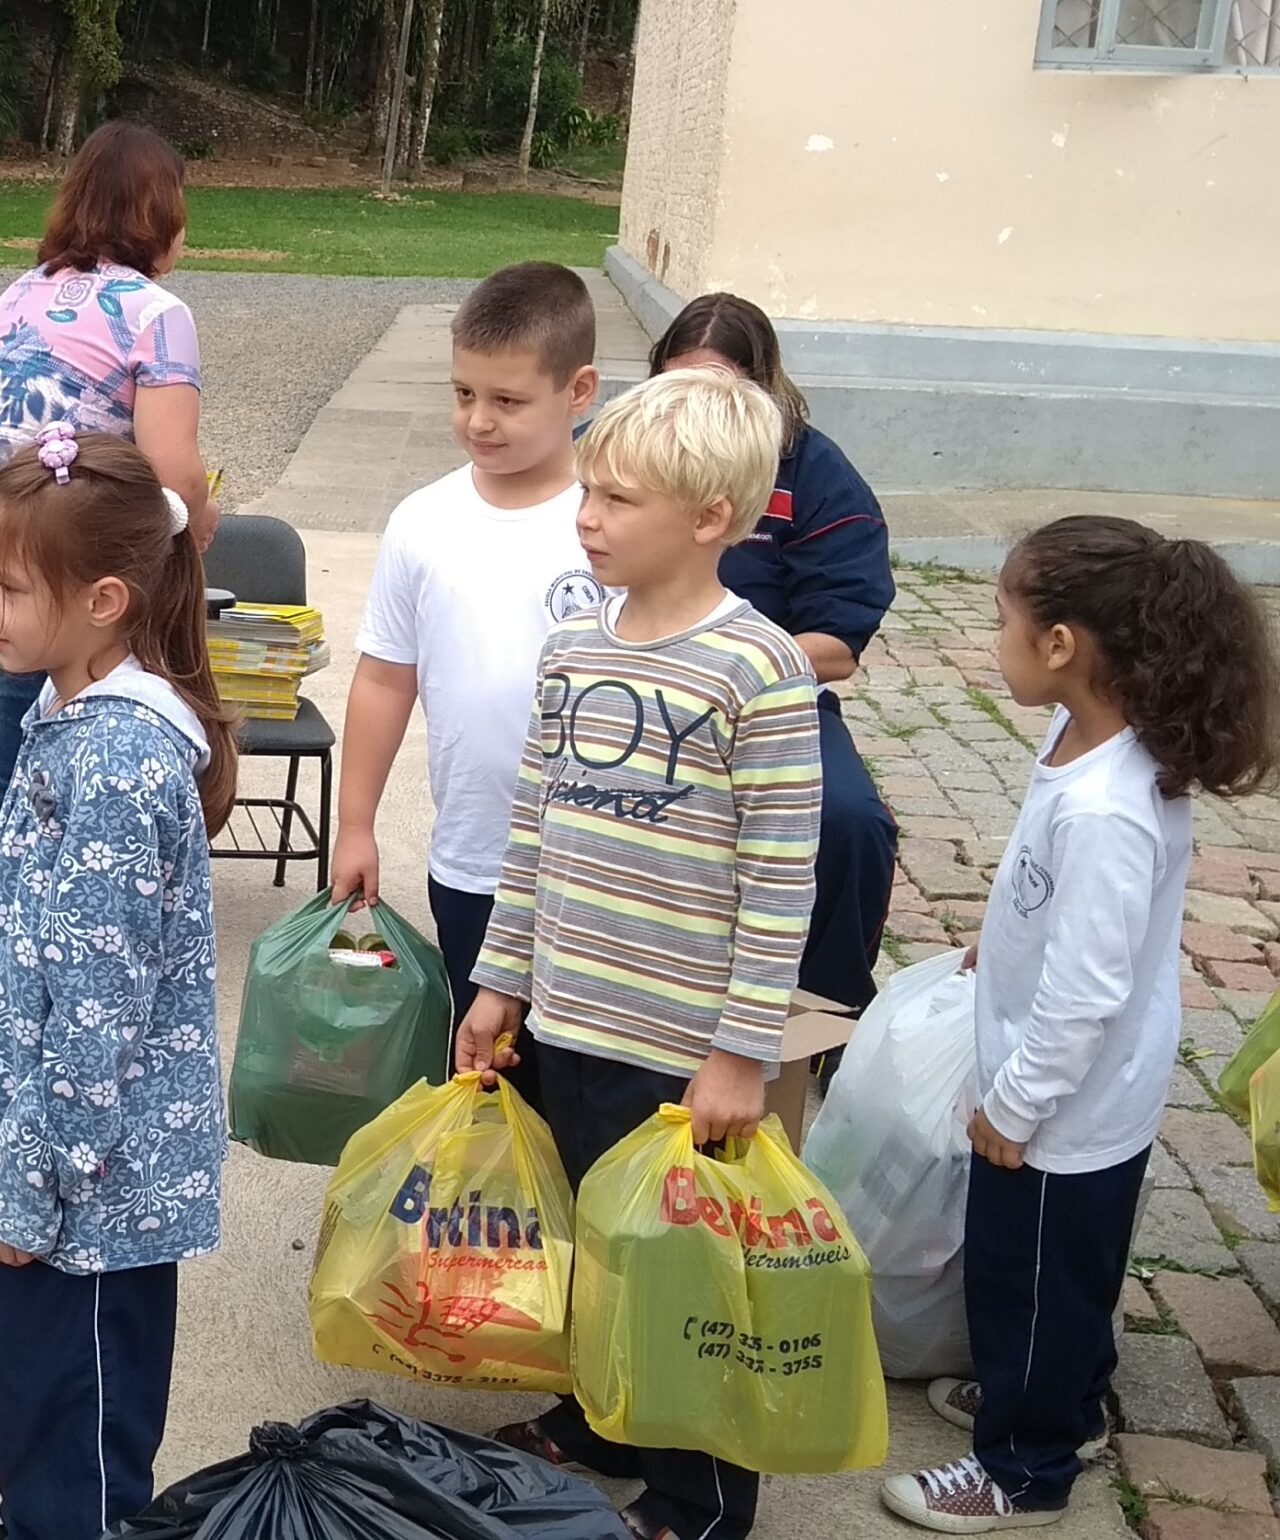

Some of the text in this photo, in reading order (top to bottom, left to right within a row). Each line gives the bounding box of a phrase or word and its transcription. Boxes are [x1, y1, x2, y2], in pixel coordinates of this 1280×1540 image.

[540, 672, 718, 787] BOY
[388, 1164, 544, 1250] Brtina
[659, 1164, 843, 1249] Berina
[743, 1245, 851, 1270] letromóveis
[697, 1341, 731, 1360] (47)
[782, 1354, 823, 1377] 3755
[701, 1319, 735, 1340] (47)
[779, 1332, 822, 1354] 0106
